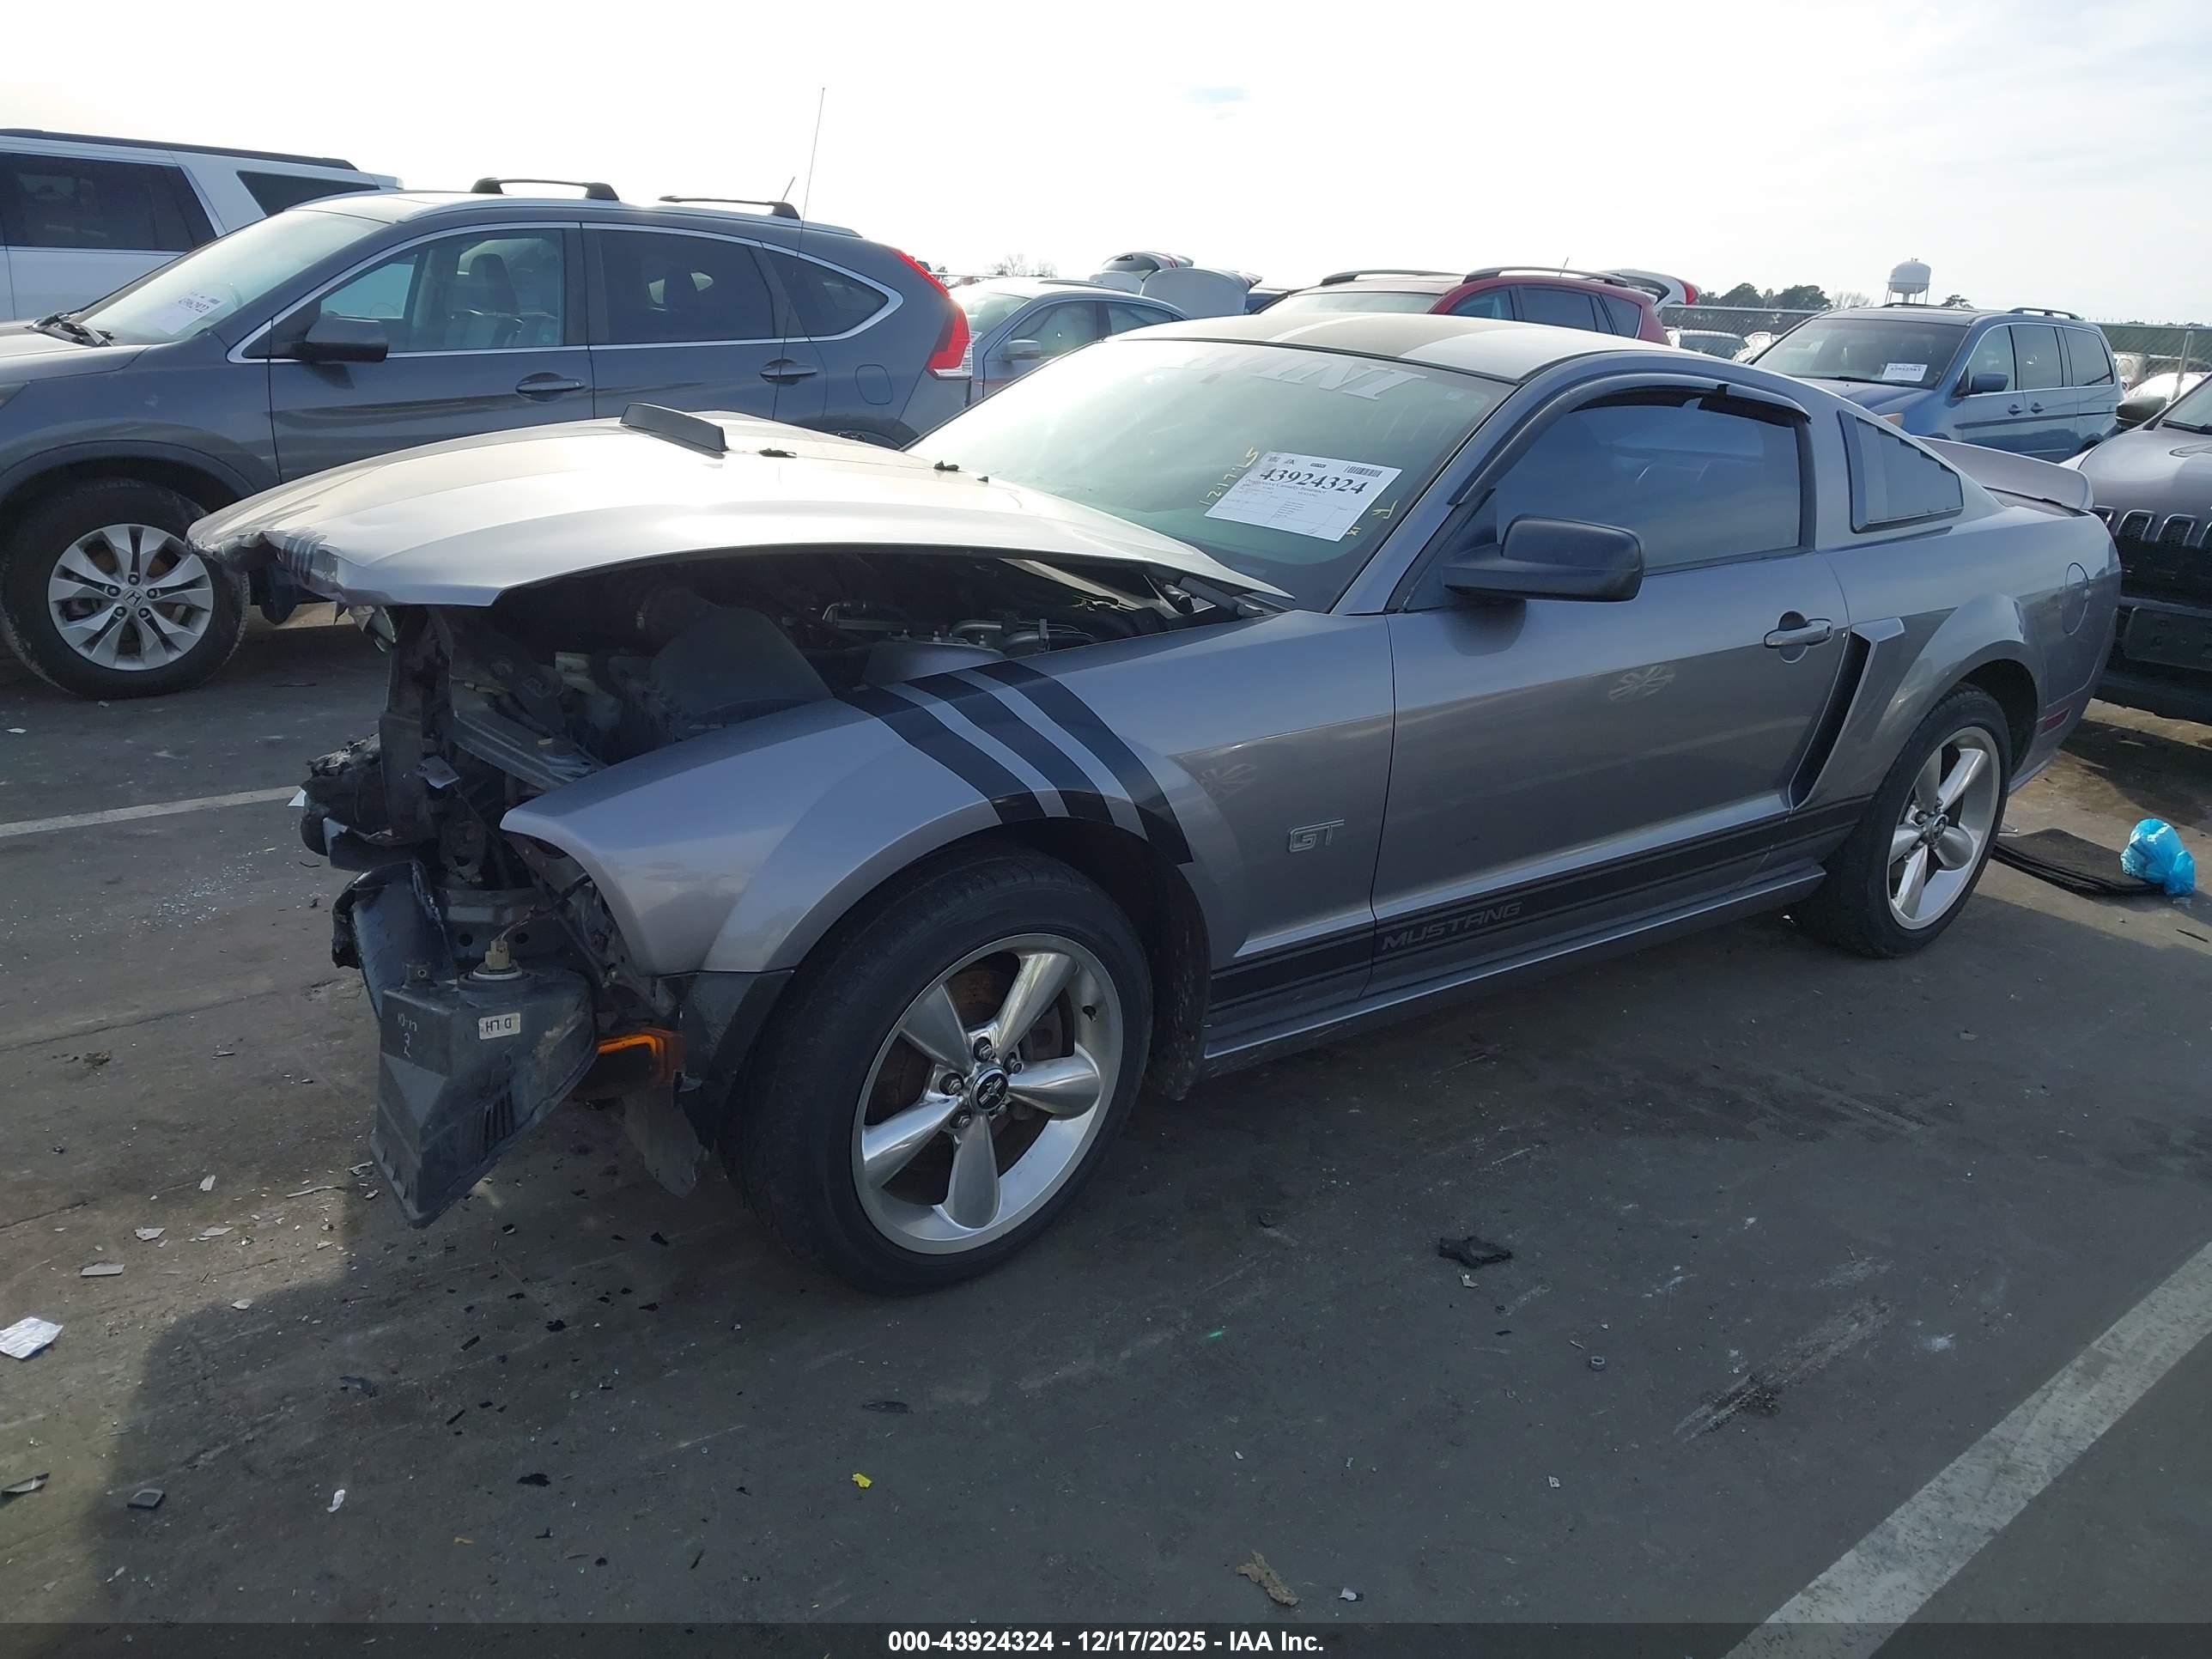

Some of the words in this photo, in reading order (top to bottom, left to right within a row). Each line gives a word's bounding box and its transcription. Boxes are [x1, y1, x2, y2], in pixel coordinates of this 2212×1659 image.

[1260, 468, 1368, 494] 43924324
[1289, 818, 1345, 852] GT
[1382, 902, 1523, 951] MUSTANG
[504, 1018, 512, 1029] D
